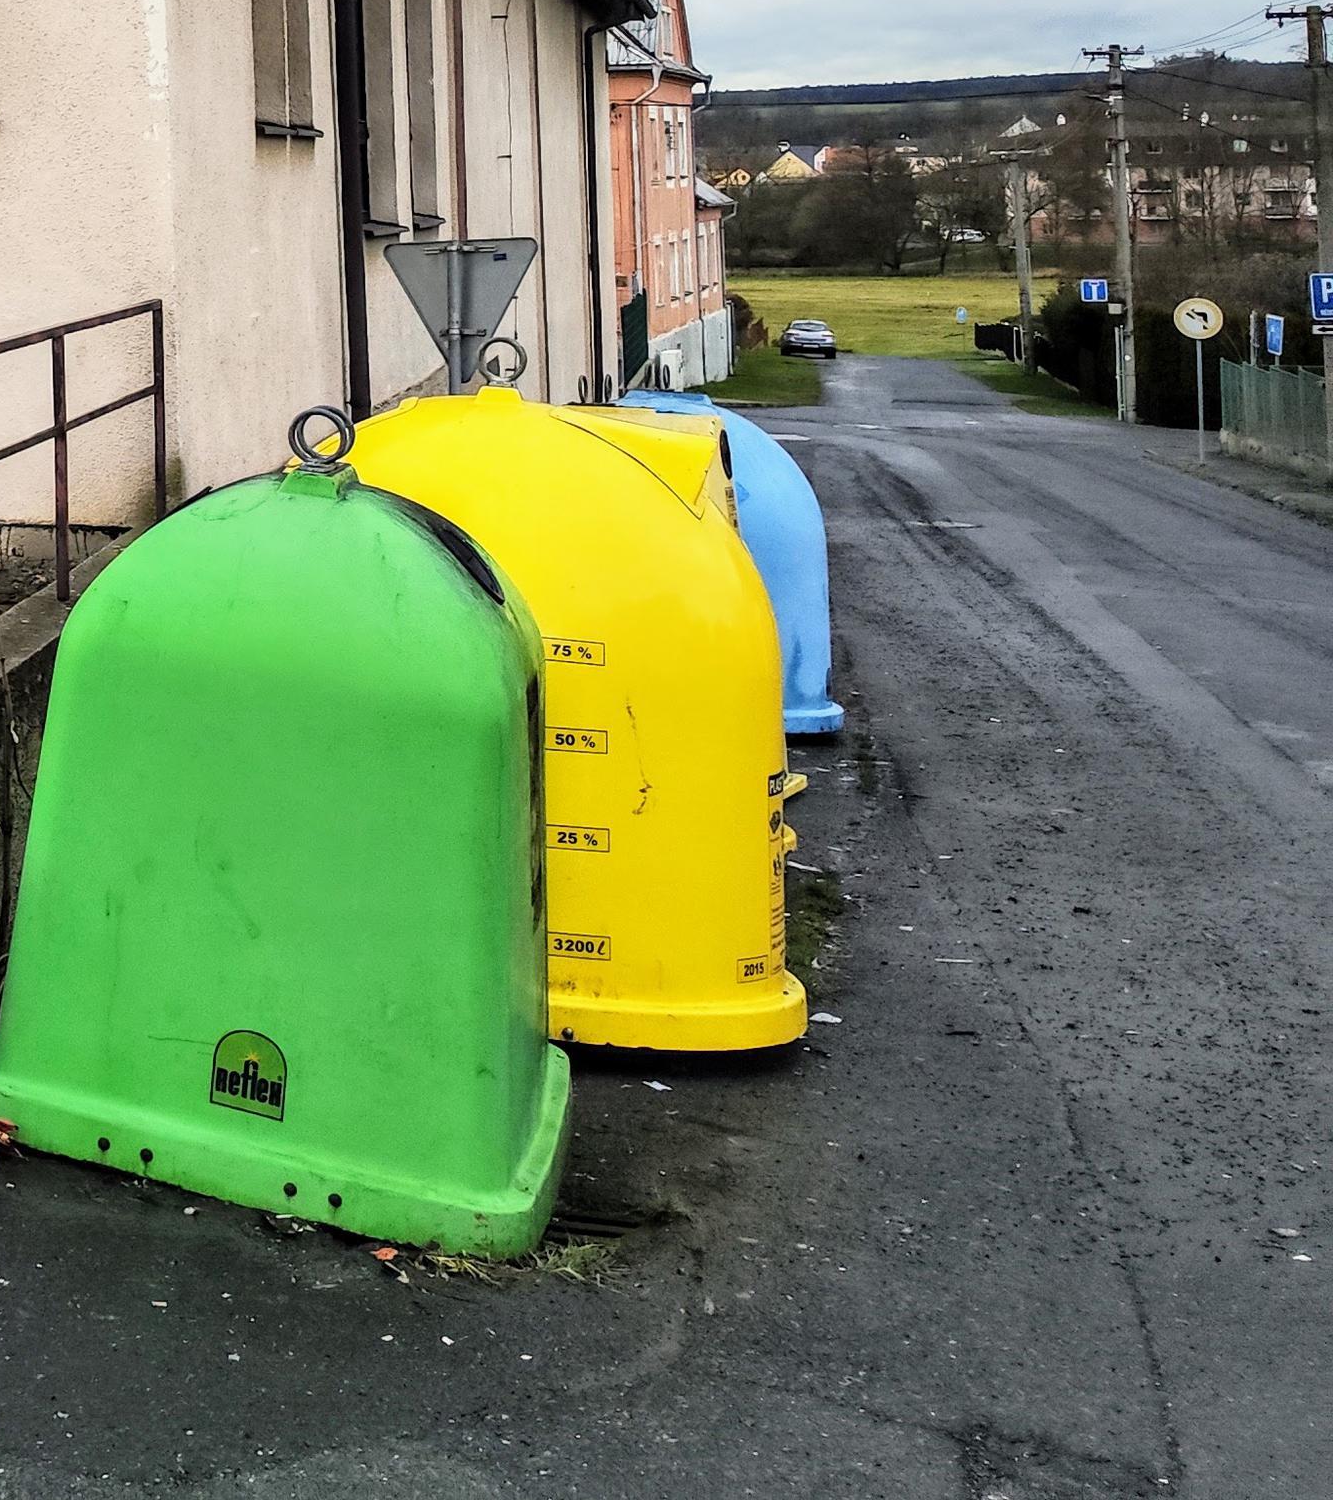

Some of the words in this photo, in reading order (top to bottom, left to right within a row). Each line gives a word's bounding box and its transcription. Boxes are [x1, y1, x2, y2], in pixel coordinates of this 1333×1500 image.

[1321, 278, 1333, 303] P
[551, 644, 572, 657] 75
[577, 646, 592, 660] %
[555, 733, 576, 746] 50
[581, 735, 596, 749] %
[557, 831, 578, 845] 25
[583, 833, 598, 846] %
[744, 962, 765, 977] 2015
